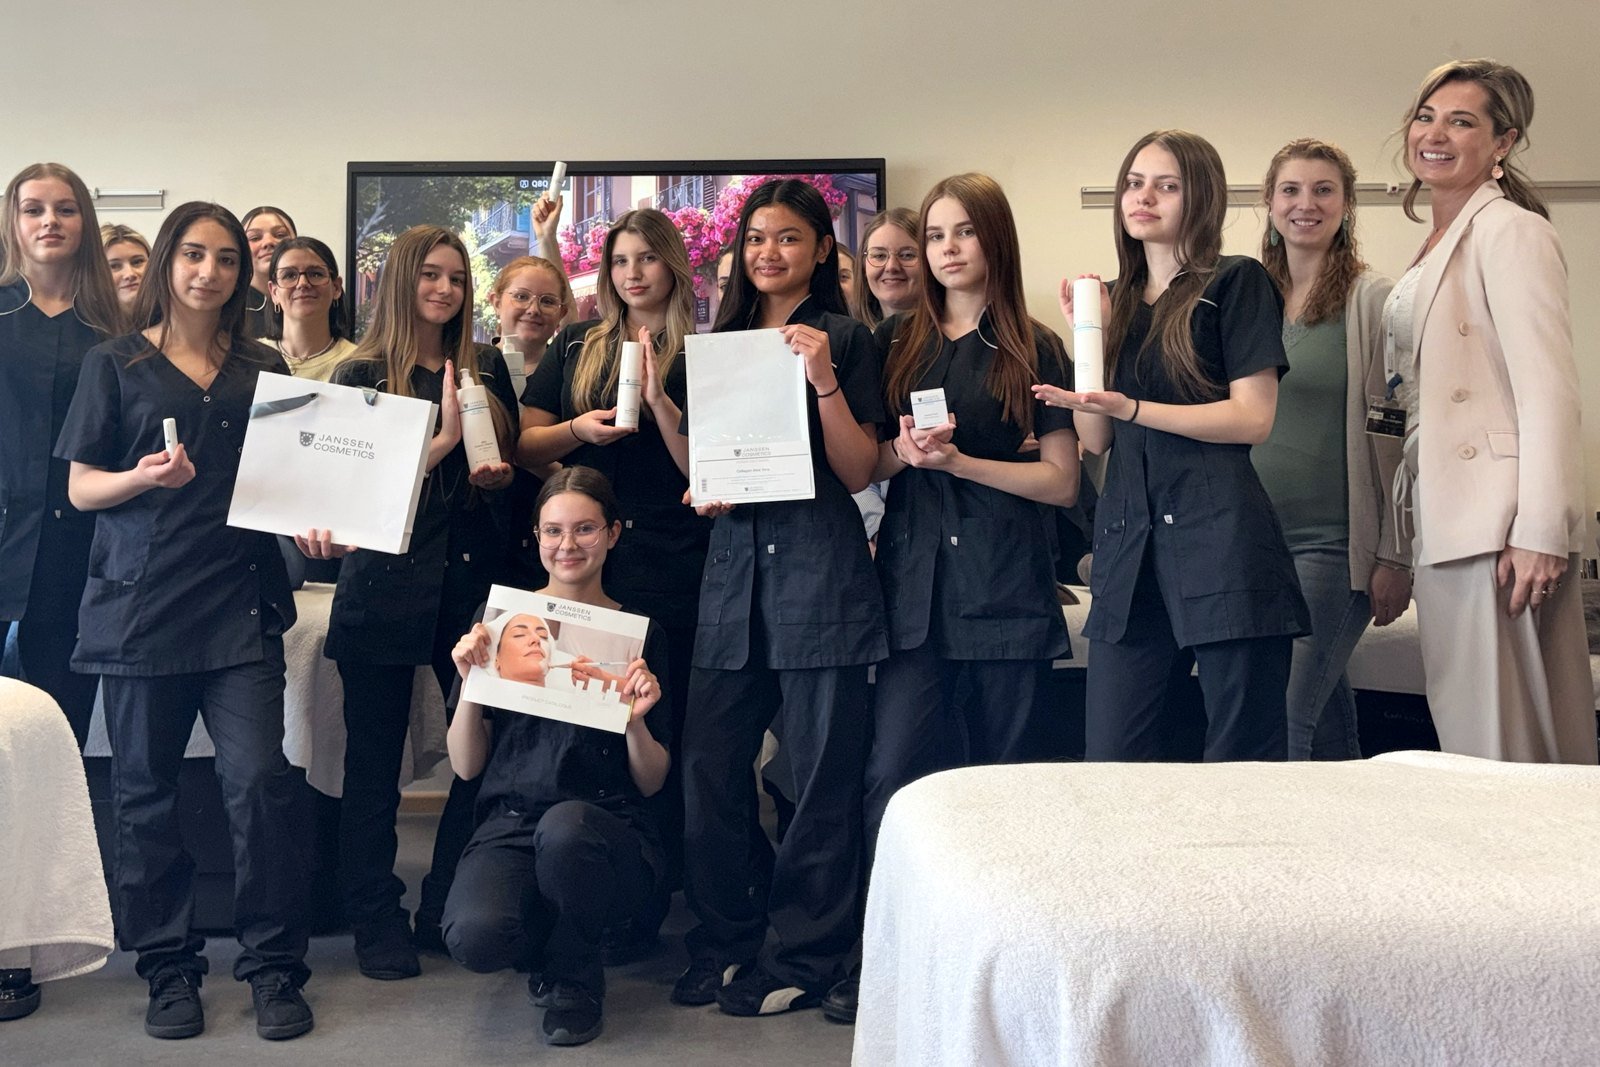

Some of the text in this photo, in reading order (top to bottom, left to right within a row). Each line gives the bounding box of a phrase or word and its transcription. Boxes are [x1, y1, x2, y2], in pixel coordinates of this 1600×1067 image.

[318, 434, 374, 449] JANSSEN
[313, 442, 375, 460] COSMETICS
[554, 609, 592, 622] COSMETICS
[558, 604, 592, 616] JANSSEN
